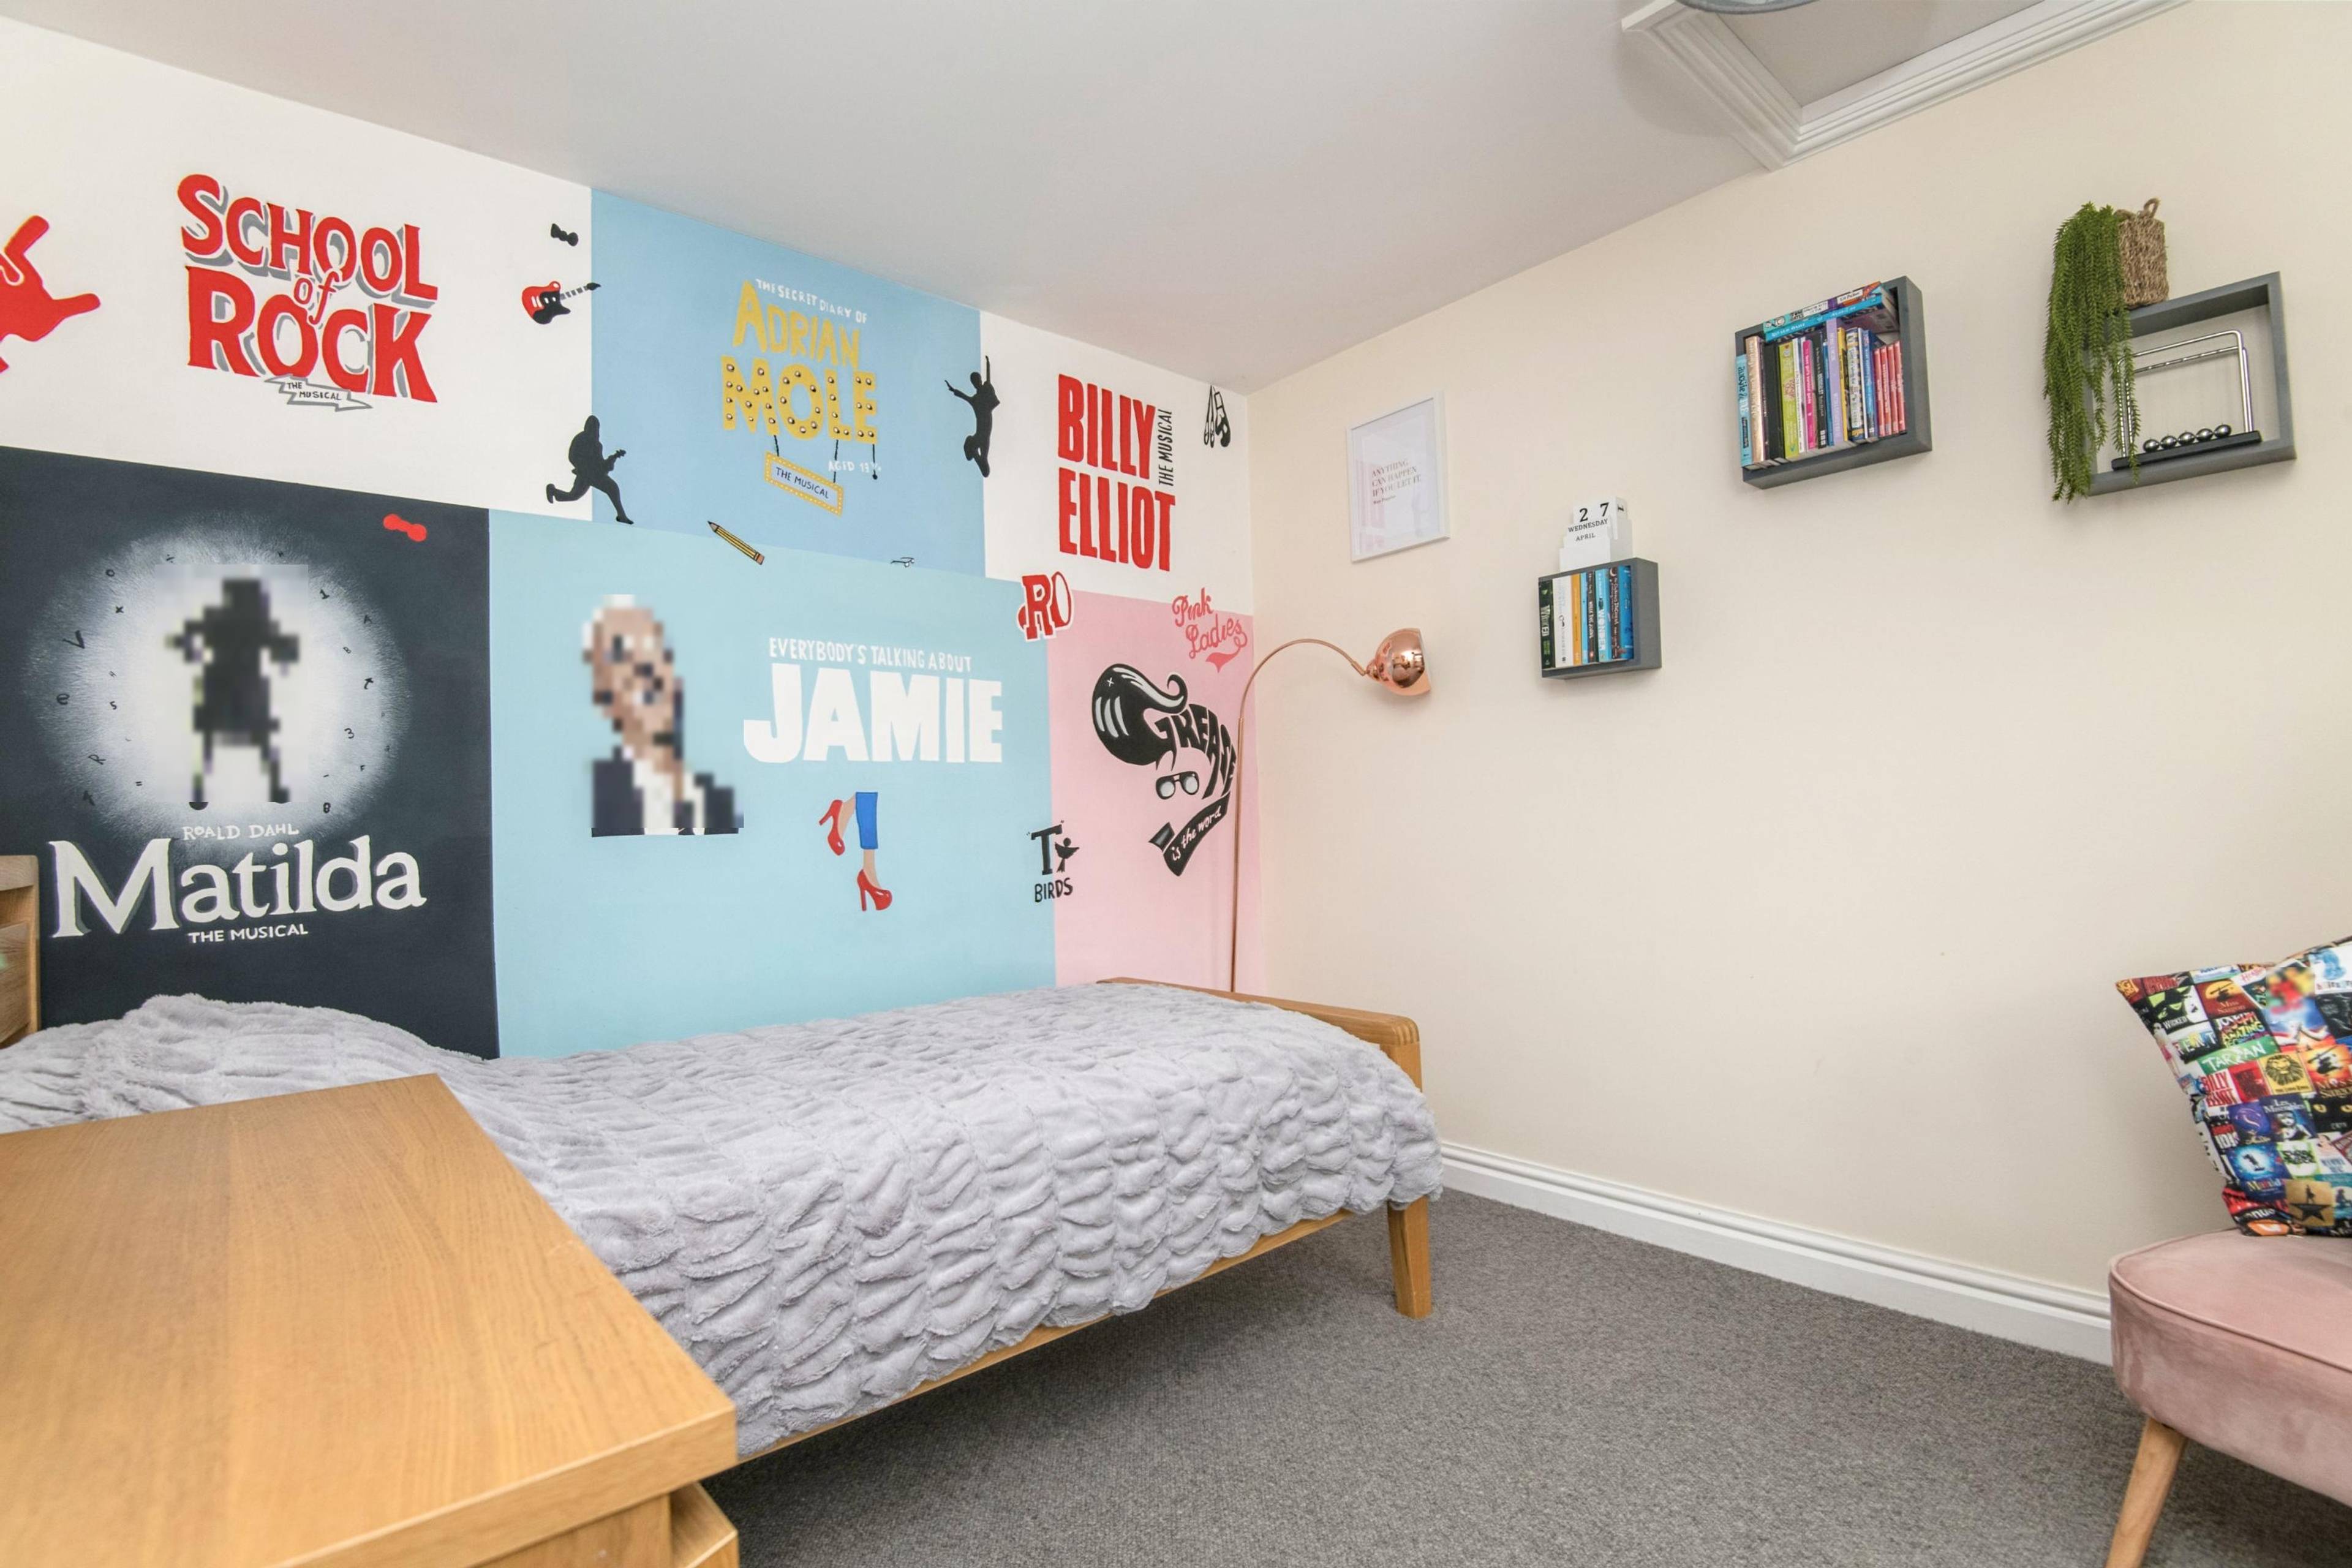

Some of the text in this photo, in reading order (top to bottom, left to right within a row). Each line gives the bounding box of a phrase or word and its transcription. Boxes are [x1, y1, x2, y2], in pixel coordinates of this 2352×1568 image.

[178, 173, 439, 304] SCHOOL
[293, 271, 341, 324] of
[756, 279, 867, 323] THE SECRET DIARY OF
[185, 266, 439, 403] ROCK
[733, 279, 861, 369] ADRIAN
[299, 391, 342, 401] MUSICAL
[720, 355, 878, 444] MOLE
[1058, 374, 1156, 480] BILLY
[1158, 409, 1174, 486] THE MUSICAL
[776, 467, 829, 499] THE MUSICAL
[1058, 467, 1175, 571] ELLIOT
[1568, 518, 1608, 533] WEDNESDAY
[1580, 502, 1610, 522] 2 7
[1575, 532, 1596, 542] APRIL
[1172, 587, 1214, 627] Pink
[1186, 612, 1248, 660] Ladies
[1597, 609, 1606, 650] WONDER
[769, 637, 972, 673] EVERYBODY'S TALKING ABOUT
[744, 663, 1003, 763] JAMIE
[182, 823, 300, 840] ROALD DAHL
[1172, 805, 1222, 861] is the word
[48, 834, 428, 939] Matilda
[1035, 877, 1073, 903] BIRDS
[187, 923, 309, 944] THE MUSICAL
[2163, 1016, 2188, 1030] WICKED
[2201, 1041, 2267, 1071] TARZAN
